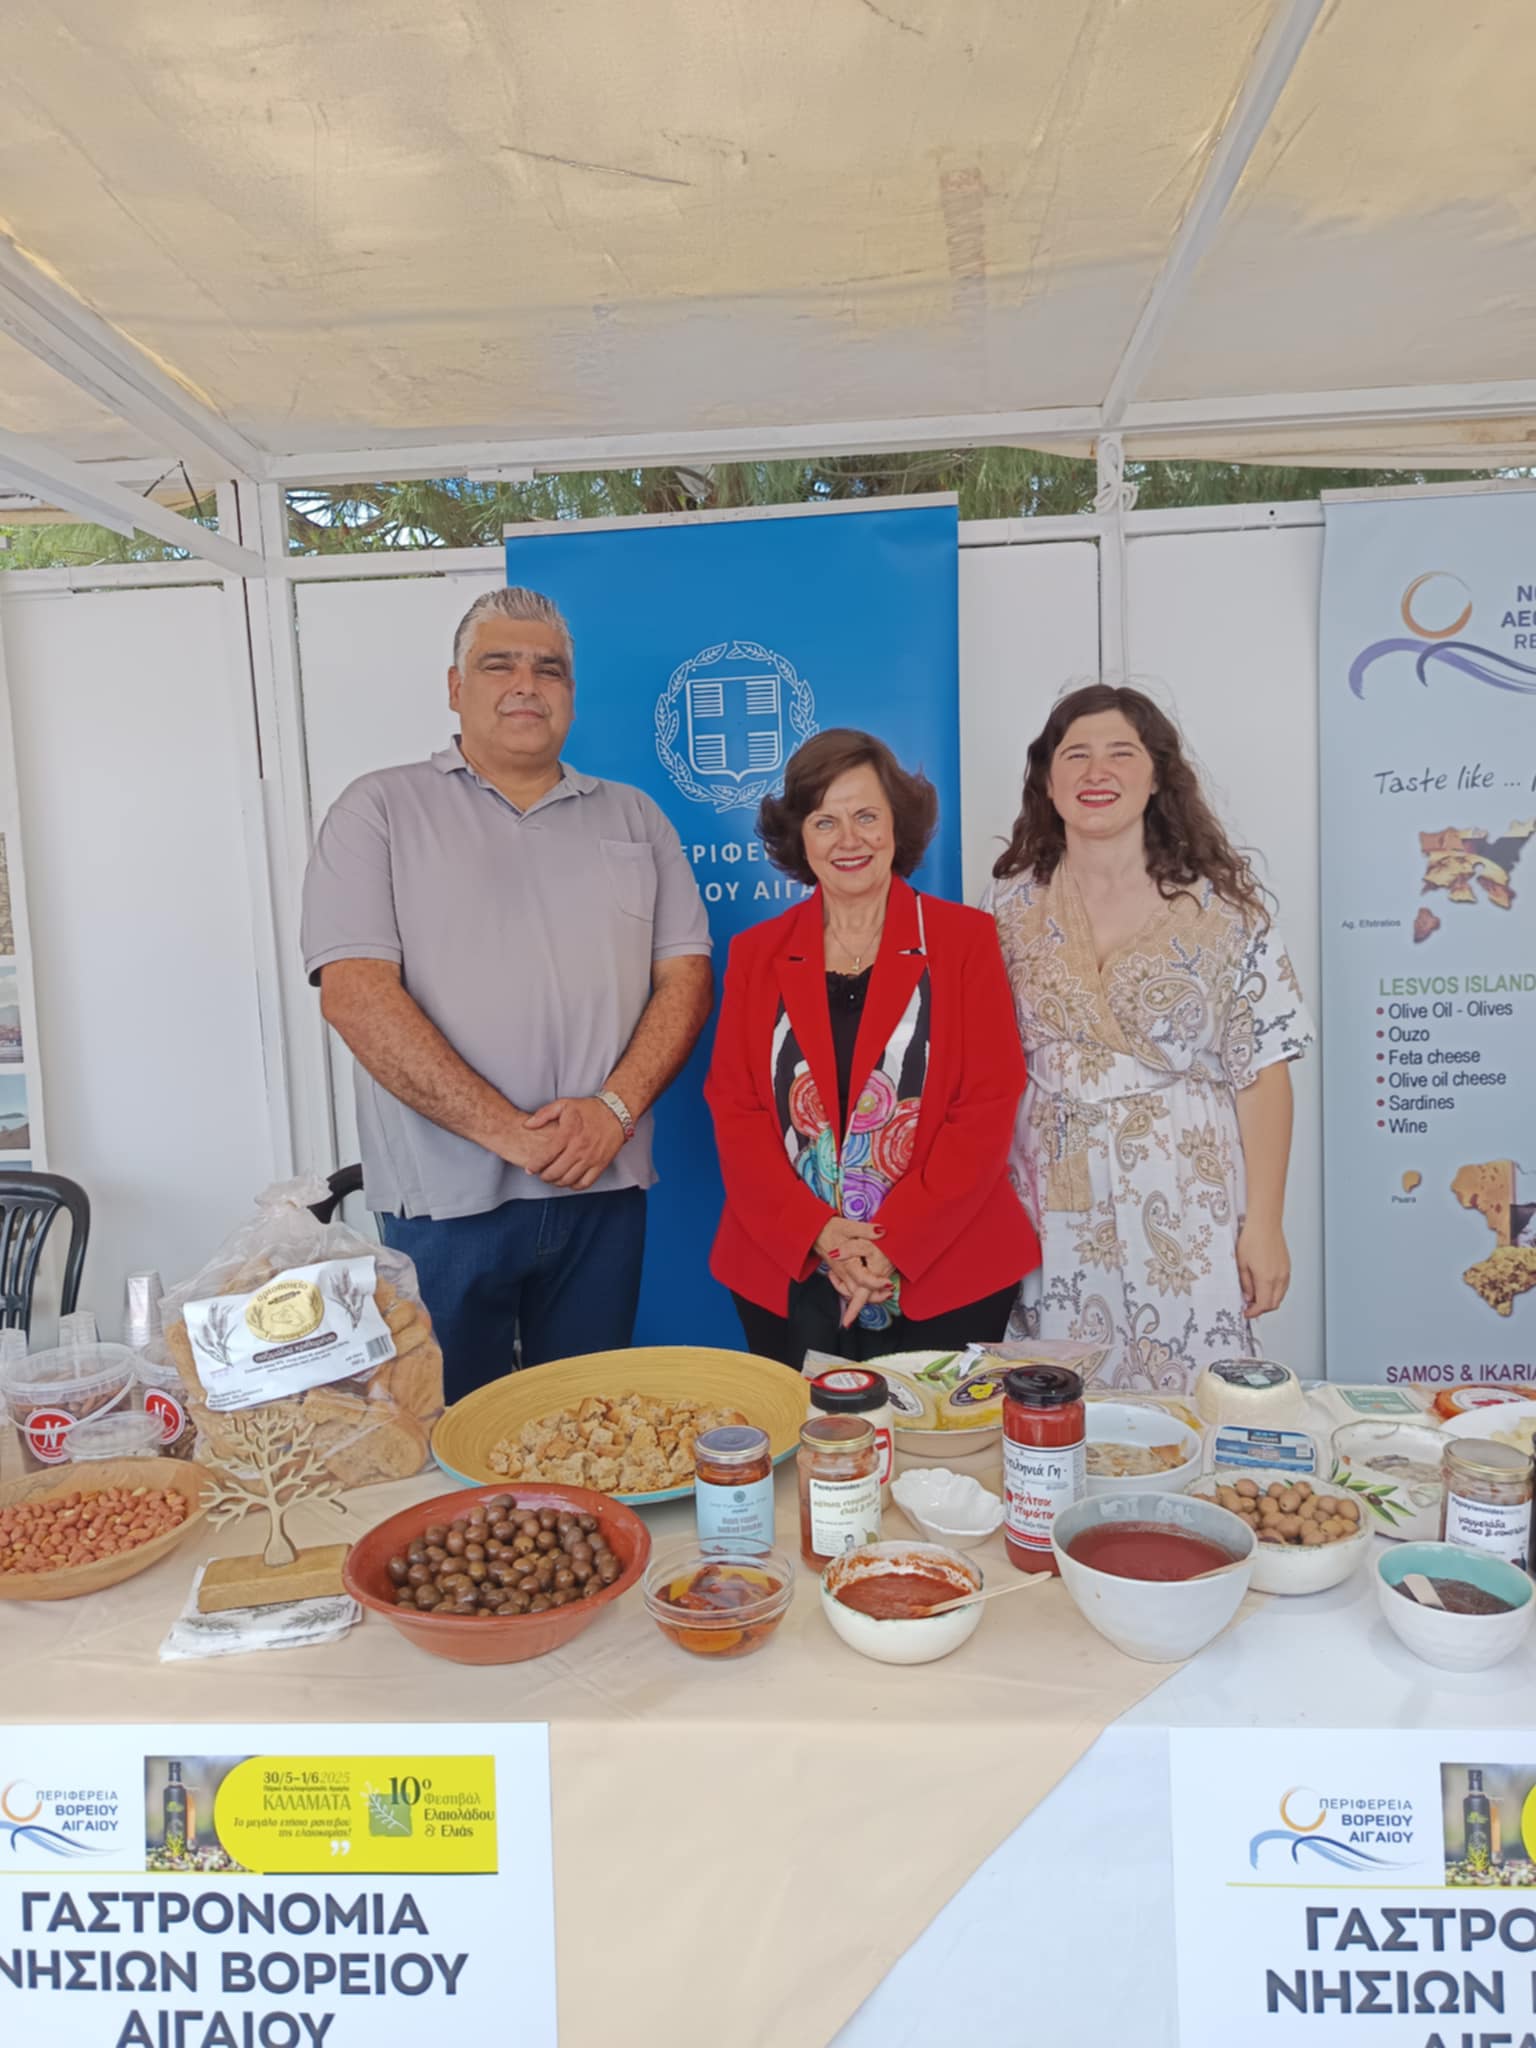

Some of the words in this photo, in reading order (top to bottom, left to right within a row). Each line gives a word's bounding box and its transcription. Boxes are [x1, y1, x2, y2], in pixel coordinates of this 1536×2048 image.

[1374, 767, 1448, 794] Taste
[1457, 763, 1495, 791] like
[1379, 976, 1459, 996] LESVOS
[1465, 974, 1536, 993] ISLAND
[1388, 1003, 1428, 1019] Olive
[1432, 1002, 1452, 1018] Oil
[1467, 1000, 1513, 1017] Olives
[1388, 1026, 1430, 1042] Ouzo
[1388, 1049, 1423, 1065] Feta
[1427, 1048, 1480, 1064] cheese
[1388, 1072, 1428, 1088] Olive
[1432, 1071, 1448, 1087] oil
[1453, 1071, 1506, 1086] cheese
[1388, 1095, 1455, 1111] Sardines
[1388, 1118, 1428, 1134] Wine
[1386, 1364, 1455, 1383] SAMOS
[1460, 1365, 1473, 1381] &
[36, 1790, 118, 1801] ΠΕΡΙΦΕΡΕΙΑ
[263, 1793, 351, 1811] ΚΑΛΑΜΑΤΑ
[424, 1792, 481, 1807] Φεστιβάλ
[55, 1804, 118, 1816] ΒΟΡΕΙΟΥ
[1319, 1798, 1413, 1811] ΠΕΡΙΦΕΡΕΙΑ
[424, 1808, 494, 1821] Ελαιολάδου
[1341, 1814, 1413, 1827] ΒΟΡΕΙΟΥ
[62, 1820, 118, 1832] ΑΙΓΑΙΟΥ
[441, 1825, 474, 1838] Ελιάς
[1349, 1831, 1414, 1844] ΑΙΓΑΙΟΥ
[22, 1891, 429, 1936] ΓΑΣΤΡΟΝΟΜΙΑ
[222, 1951, 469, 1997] ΒΟΡΕΙΟΥ
[1266, 1969, 1505, 2014] ΝΗΣΙΩΝ
[115, 2009, 335, 2048] ΑΙΓΑΙΟΥ
